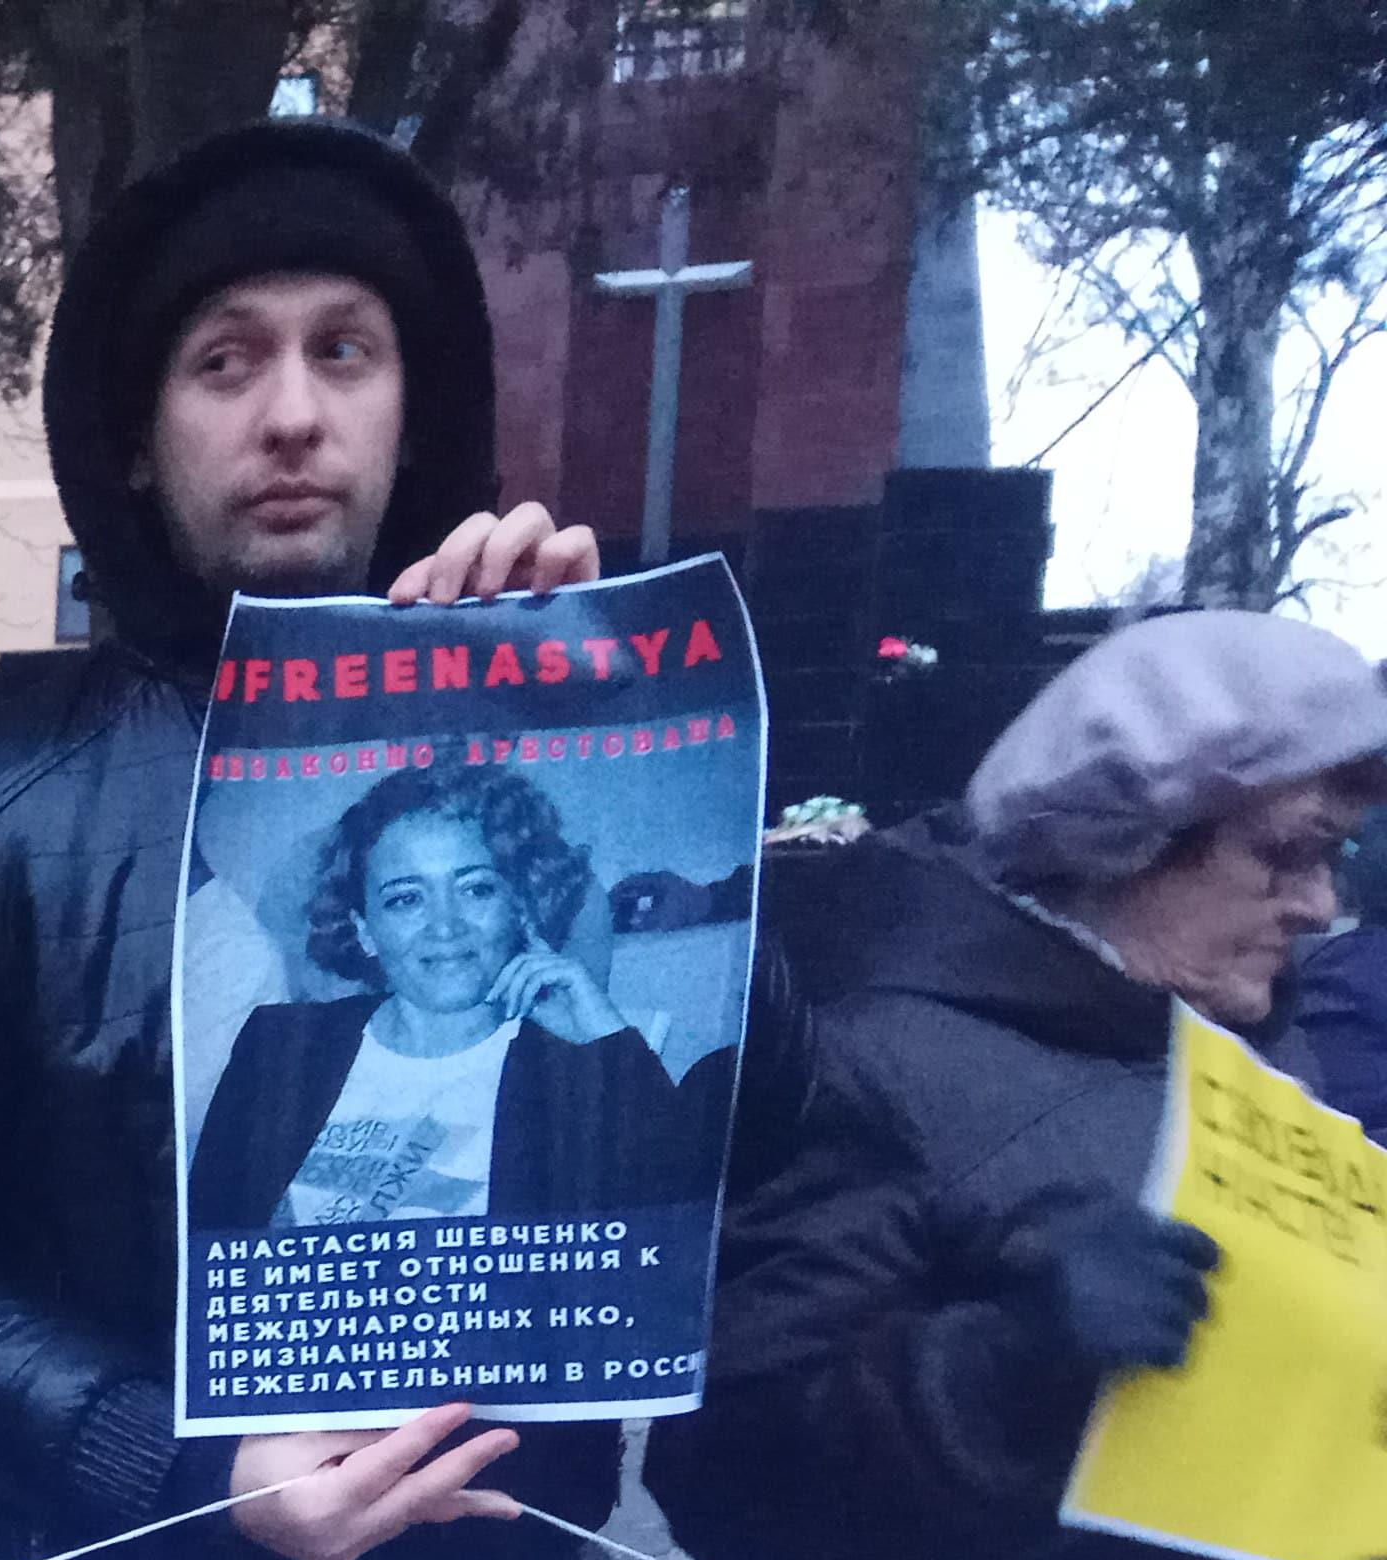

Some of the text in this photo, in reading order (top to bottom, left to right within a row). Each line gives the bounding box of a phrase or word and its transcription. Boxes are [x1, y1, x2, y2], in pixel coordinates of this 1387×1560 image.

[209, 713, 736, 782] НЕЗАКОННО АРЕСТОВАНА
[206, 1219, 629, 1262] АНАСТАСИЯ ШЕВЧЕНКО
[207, 1245, 662, 1290] НЕ ИМЕЕТ ОТНОШЕНИЯ К
[206, 1282, 488, 1320] ДЕЯТЕЛЬНОСТИ
[208, 1305, 637, 1344] МЕЖДУНАРОДНЫХ НКО,
[208, 1338, 452, 1372] ПРИЗНАННЫХ
[208, 1363, 549, 1398] НЕЖЕЛАТЕЛЬНЫМИ
[564, 1362, 585, 1382] В
